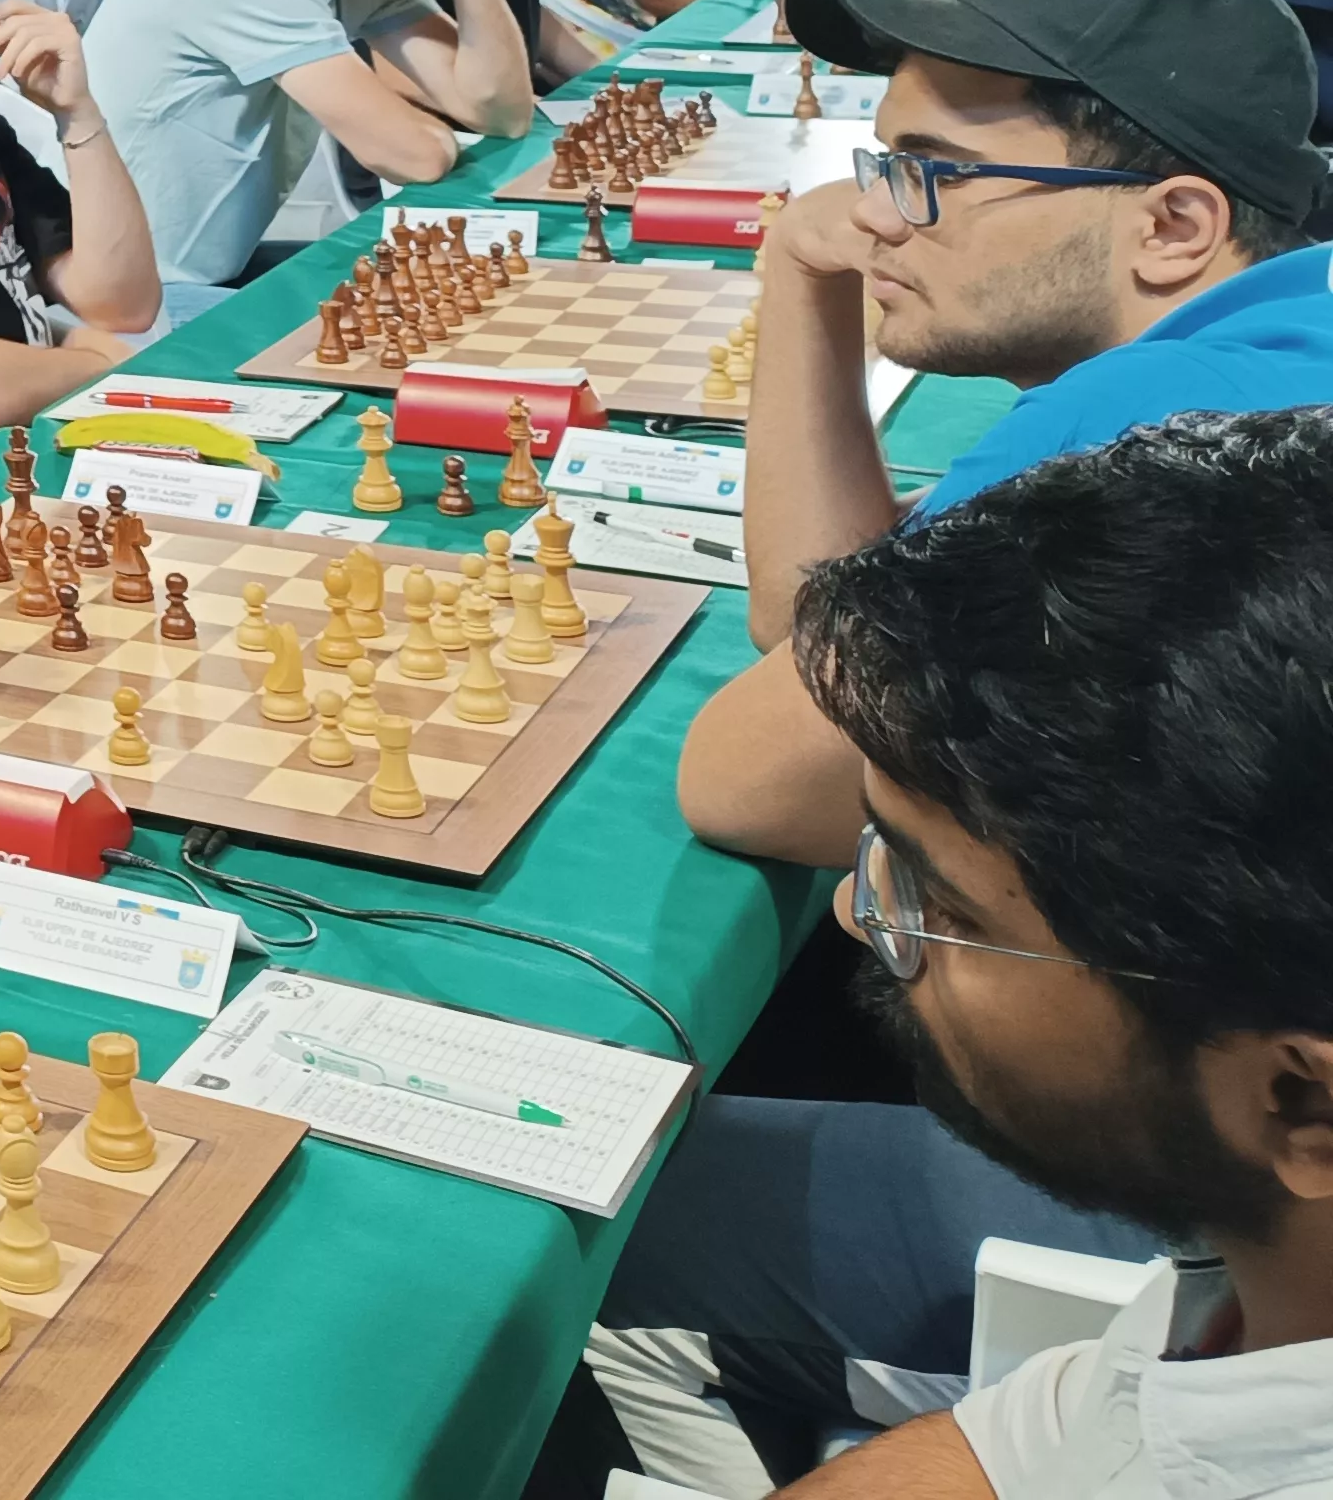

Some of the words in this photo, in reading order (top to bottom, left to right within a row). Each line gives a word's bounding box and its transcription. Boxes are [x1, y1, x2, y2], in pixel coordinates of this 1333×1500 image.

[54, 897, 118, 921] Rathanvel
[120, 911, 131, 923] V
[131, 914, 143, 927] S
[64, 937, 80, 951] DE
[80, 928, 97, 941] DE
[101, 932, 153, 955] AJEDREZ
